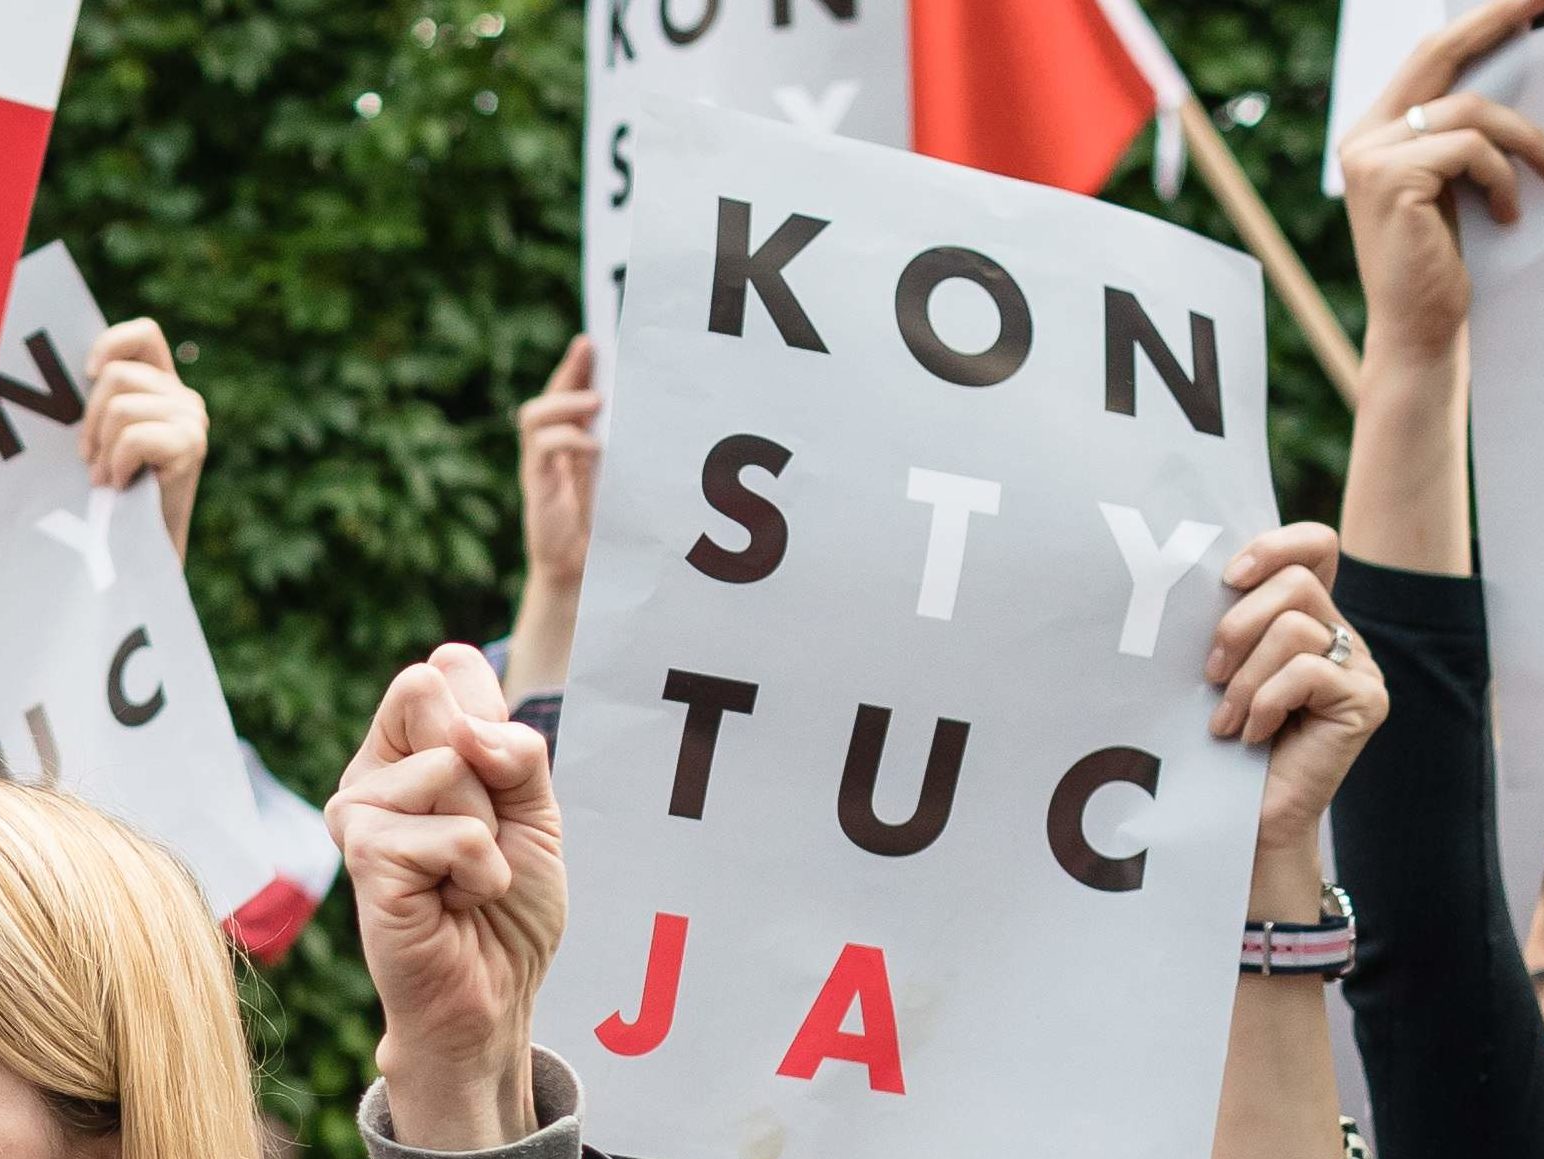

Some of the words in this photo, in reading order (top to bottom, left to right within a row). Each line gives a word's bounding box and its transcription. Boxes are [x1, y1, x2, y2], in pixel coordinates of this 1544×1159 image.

[708, 196, 1225, 438] KON
[684, 434, 1222, 658] STY
[662, 668, 1162, 892] TUC
[594, 913, 907, 1095] JA
